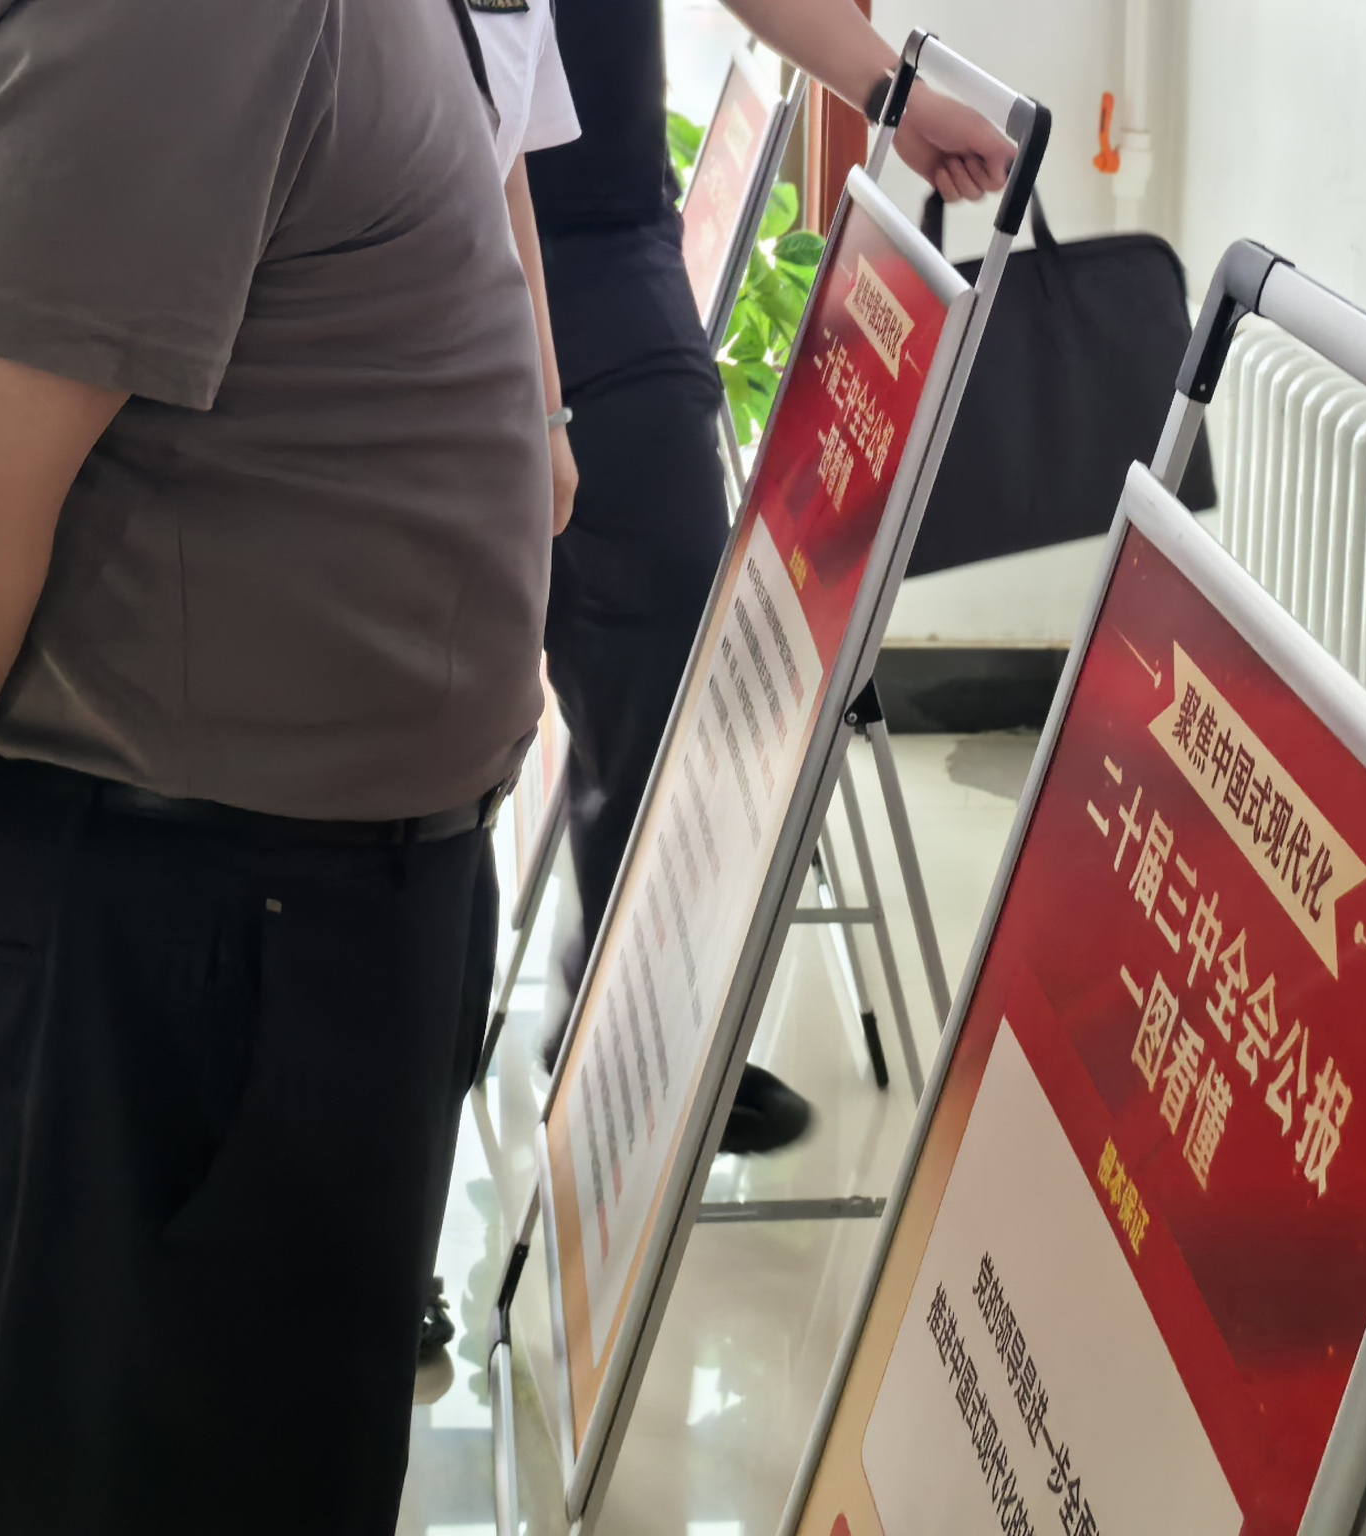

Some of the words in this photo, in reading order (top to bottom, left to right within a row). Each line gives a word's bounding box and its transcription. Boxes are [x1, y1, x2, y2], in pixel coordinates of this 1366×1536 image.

[813, 327, 895, 482] 二十届三中全会公报
[1171, 681, 1335, 924] 聚焦中国式现代化
[1086, 754, 1353, 1197] 二十届三中全会公报
[1120, 963, 1235, 1193] 一图看懂
